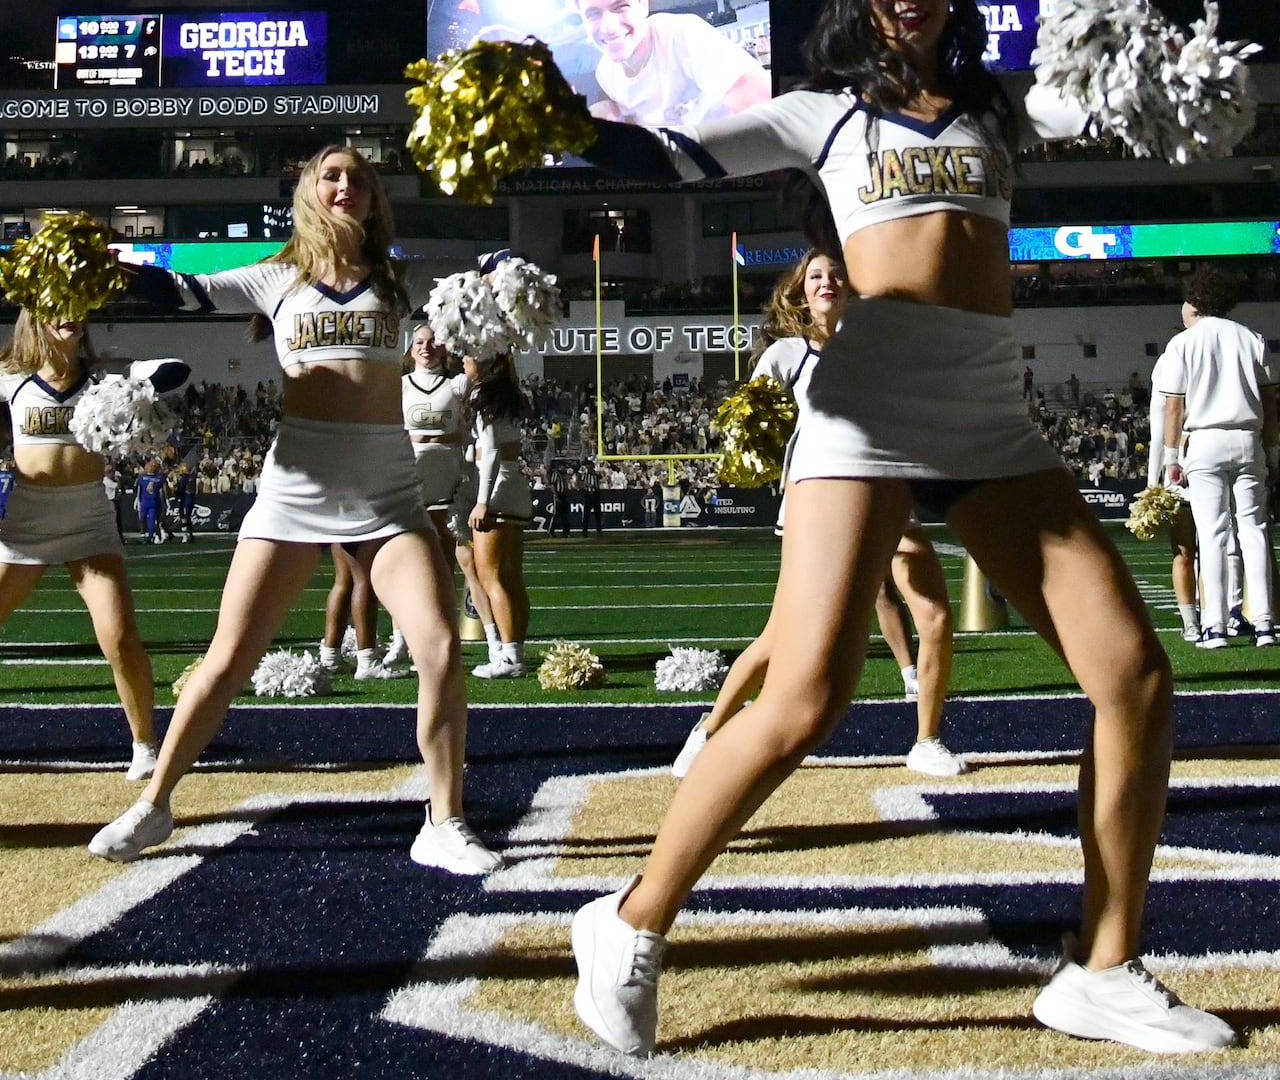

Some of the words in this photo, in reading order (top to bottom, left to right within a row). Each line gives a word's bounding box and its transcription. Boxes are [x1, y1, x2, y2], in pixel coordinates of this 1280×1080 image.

[125, 21, 137, 34] 7
[180, 21, 308, 49] GEORGIA
[124, 44, 136, 58] 7
[202, 49, 285, 77] TECH
[75, 99, 106, 117] TO
[112, 97, 193, 117] BOBBY
[198, 96, 267, 115] DODD
[273, 94, 380, 115] STADIUM
[515, 179, 590, 191] NATIONAL
[1054, 226, 1116, 259] GT
[745, 248, 809, 262] RENASAN
[287, 310, 401, 351] JACKETS
[630, 327, 673, 351] OF
[1, 478, 10, 493] 7
[146, 482, 154, 494] 4
